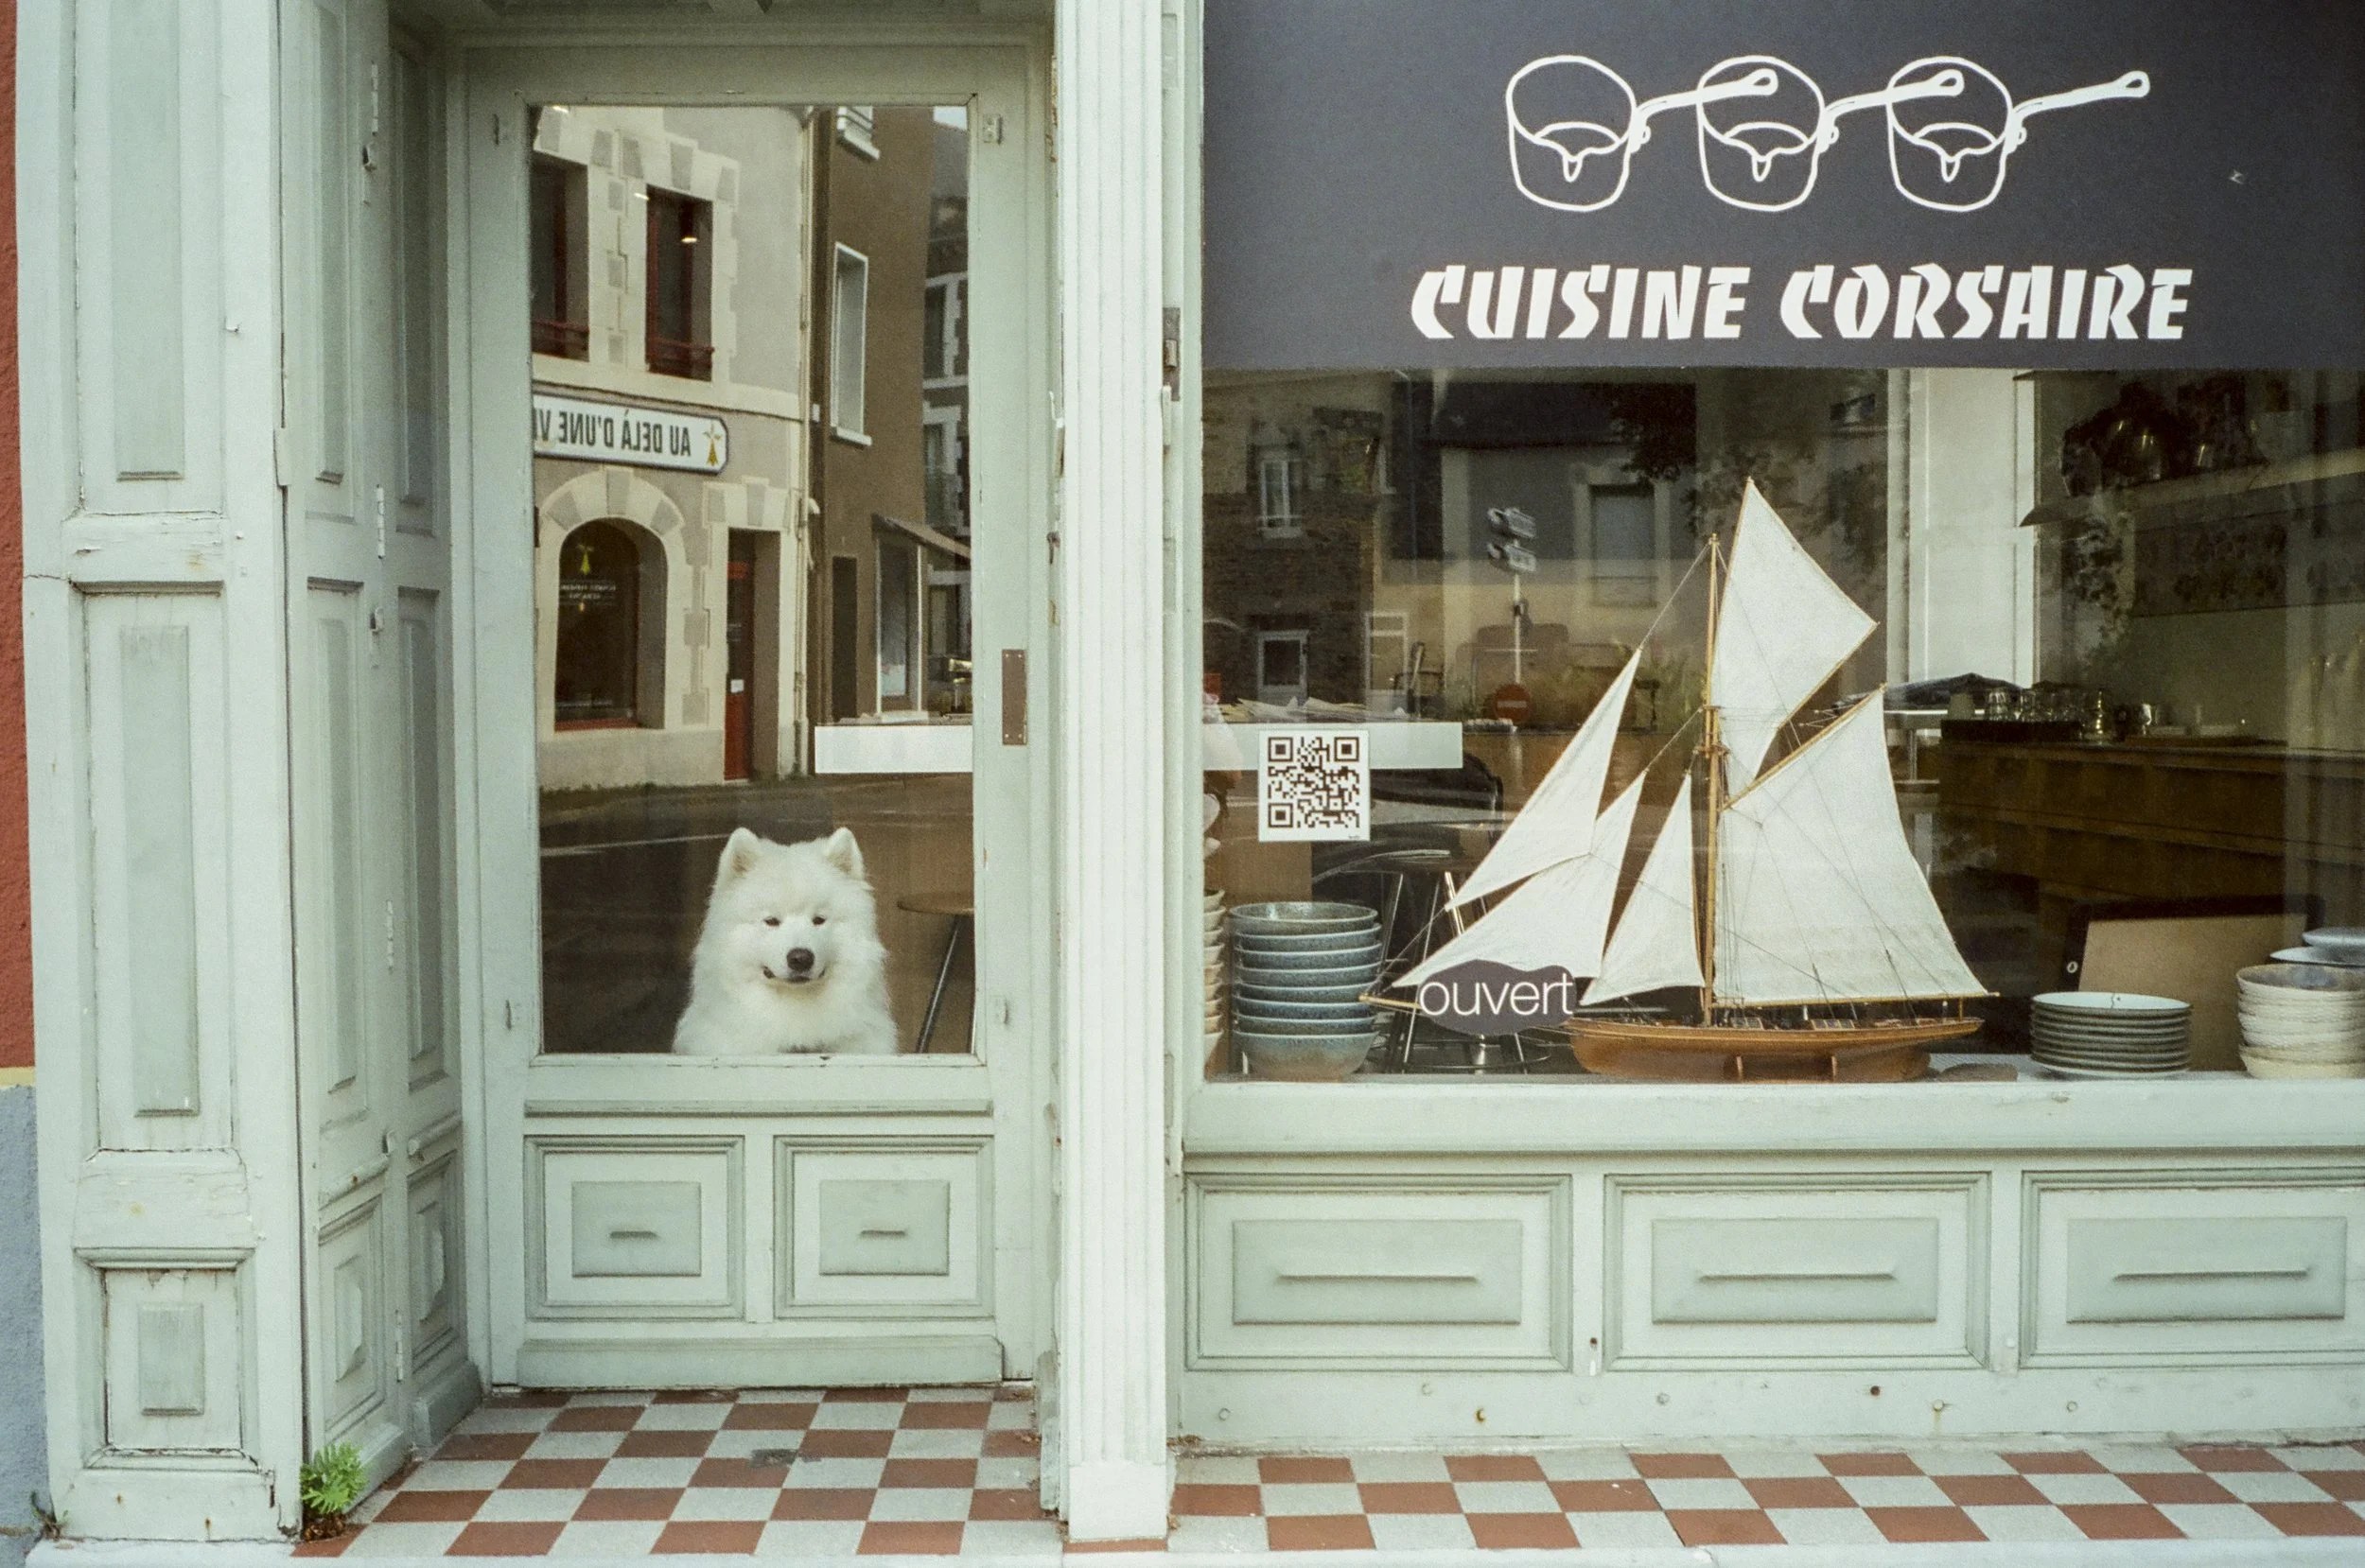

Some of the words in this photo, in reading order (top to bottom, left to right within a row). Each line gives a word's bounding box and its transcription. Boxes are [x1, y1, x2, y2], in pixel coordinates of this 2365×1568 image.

[1410, 264, 1751, 340] CUISINE
[1779, 262, 2193, 340] CORSAIRE
[1419, 972, 1574, 1016] ouvert
